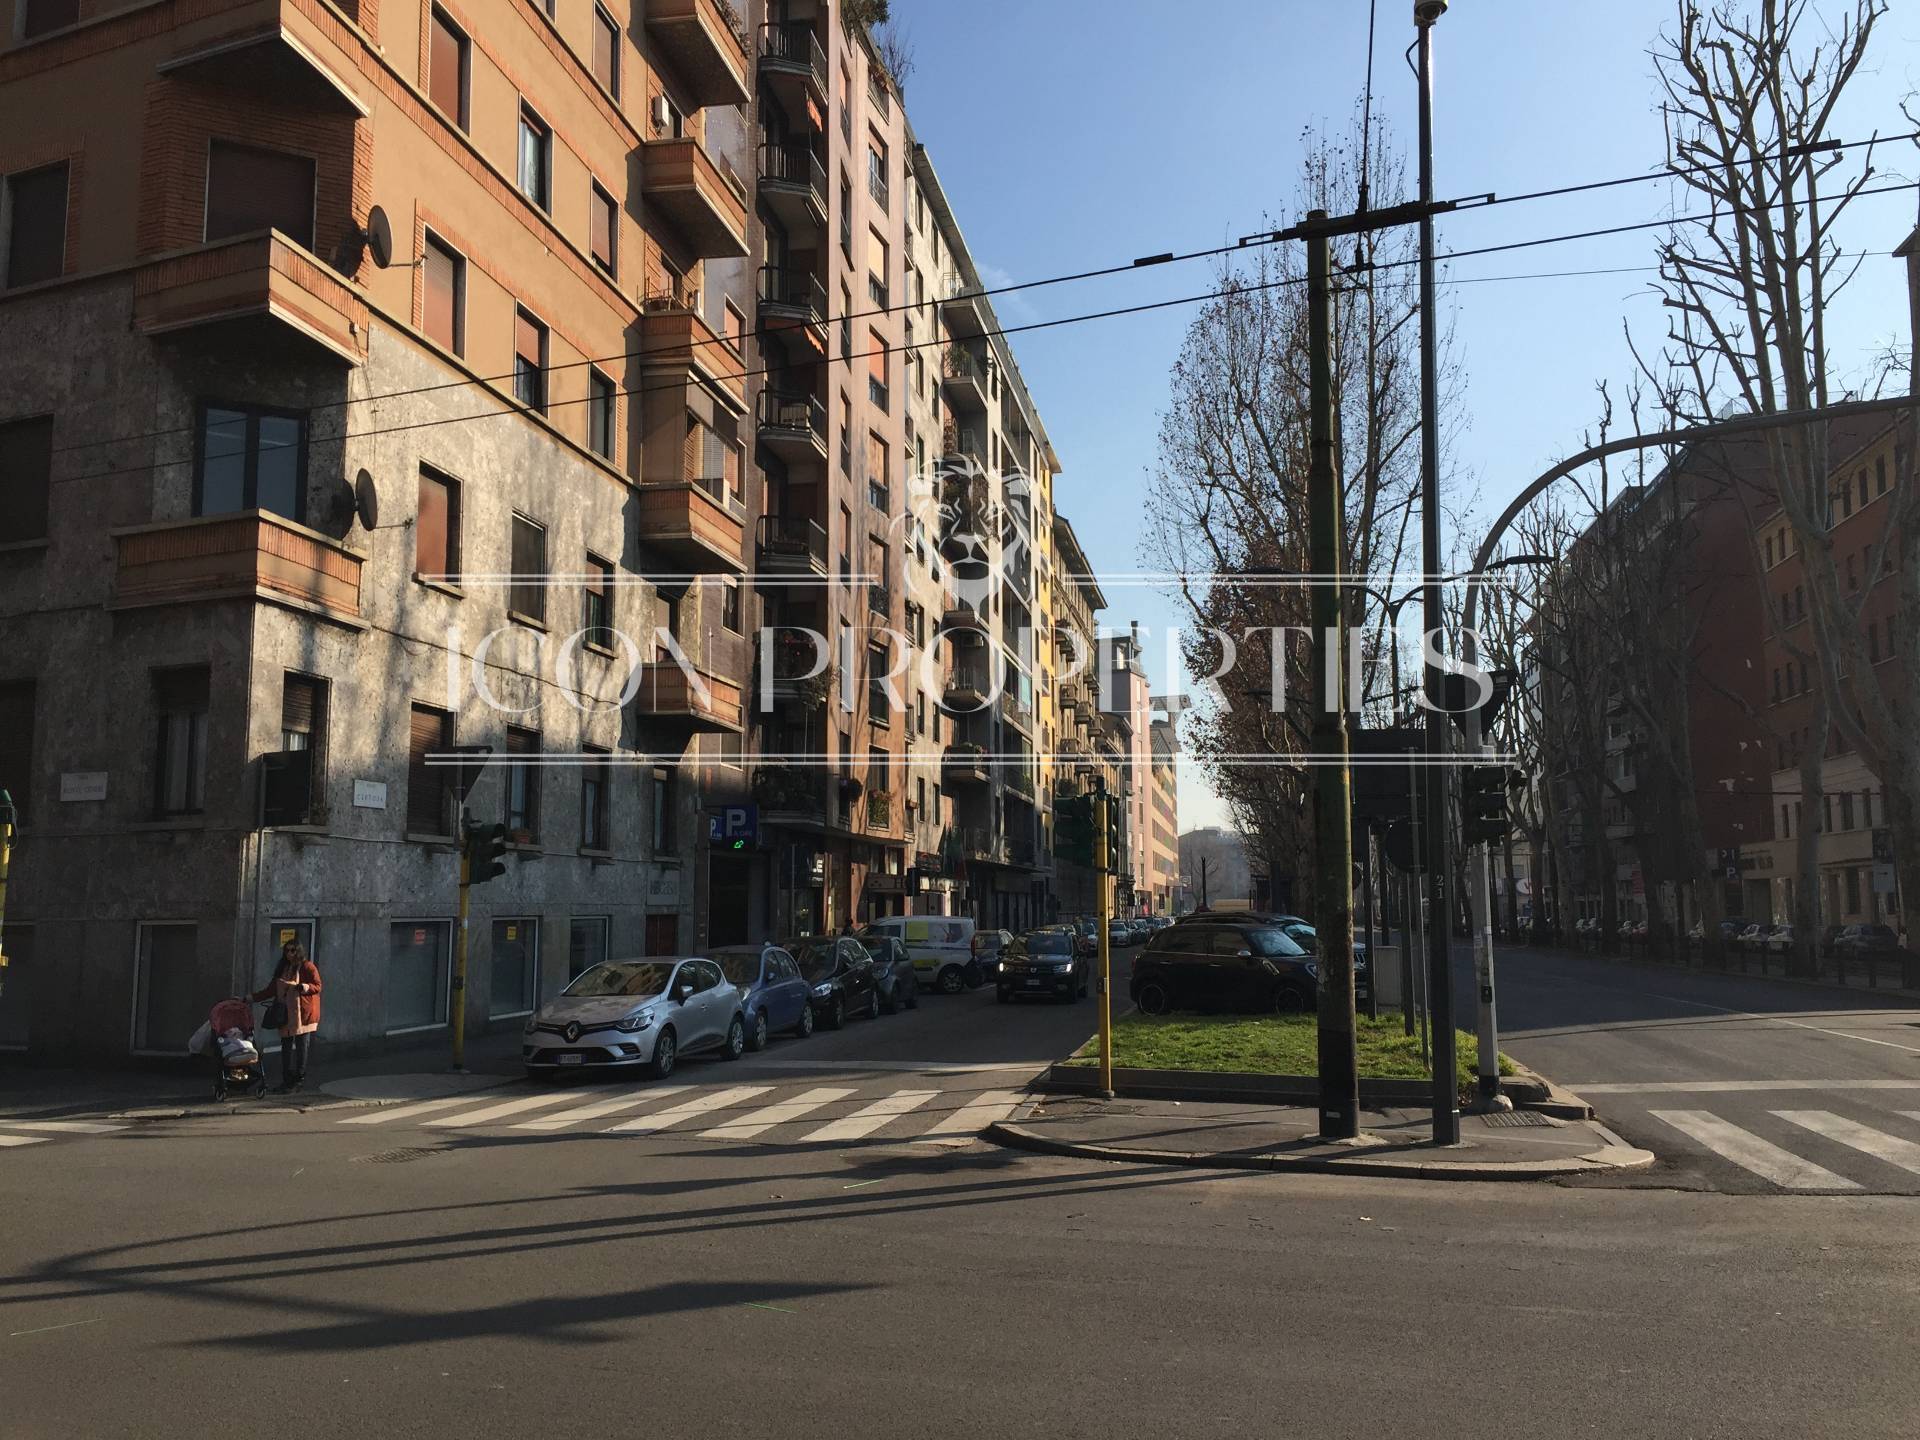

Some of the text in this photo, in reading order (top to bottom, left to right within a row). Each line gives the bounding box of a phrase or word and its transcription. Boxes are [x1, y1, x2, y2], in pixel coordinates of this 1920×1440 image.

[710, 818, 717, 837] P
[726, 809, 746, 838] P
[1433, 874, 1444, 886] 2
